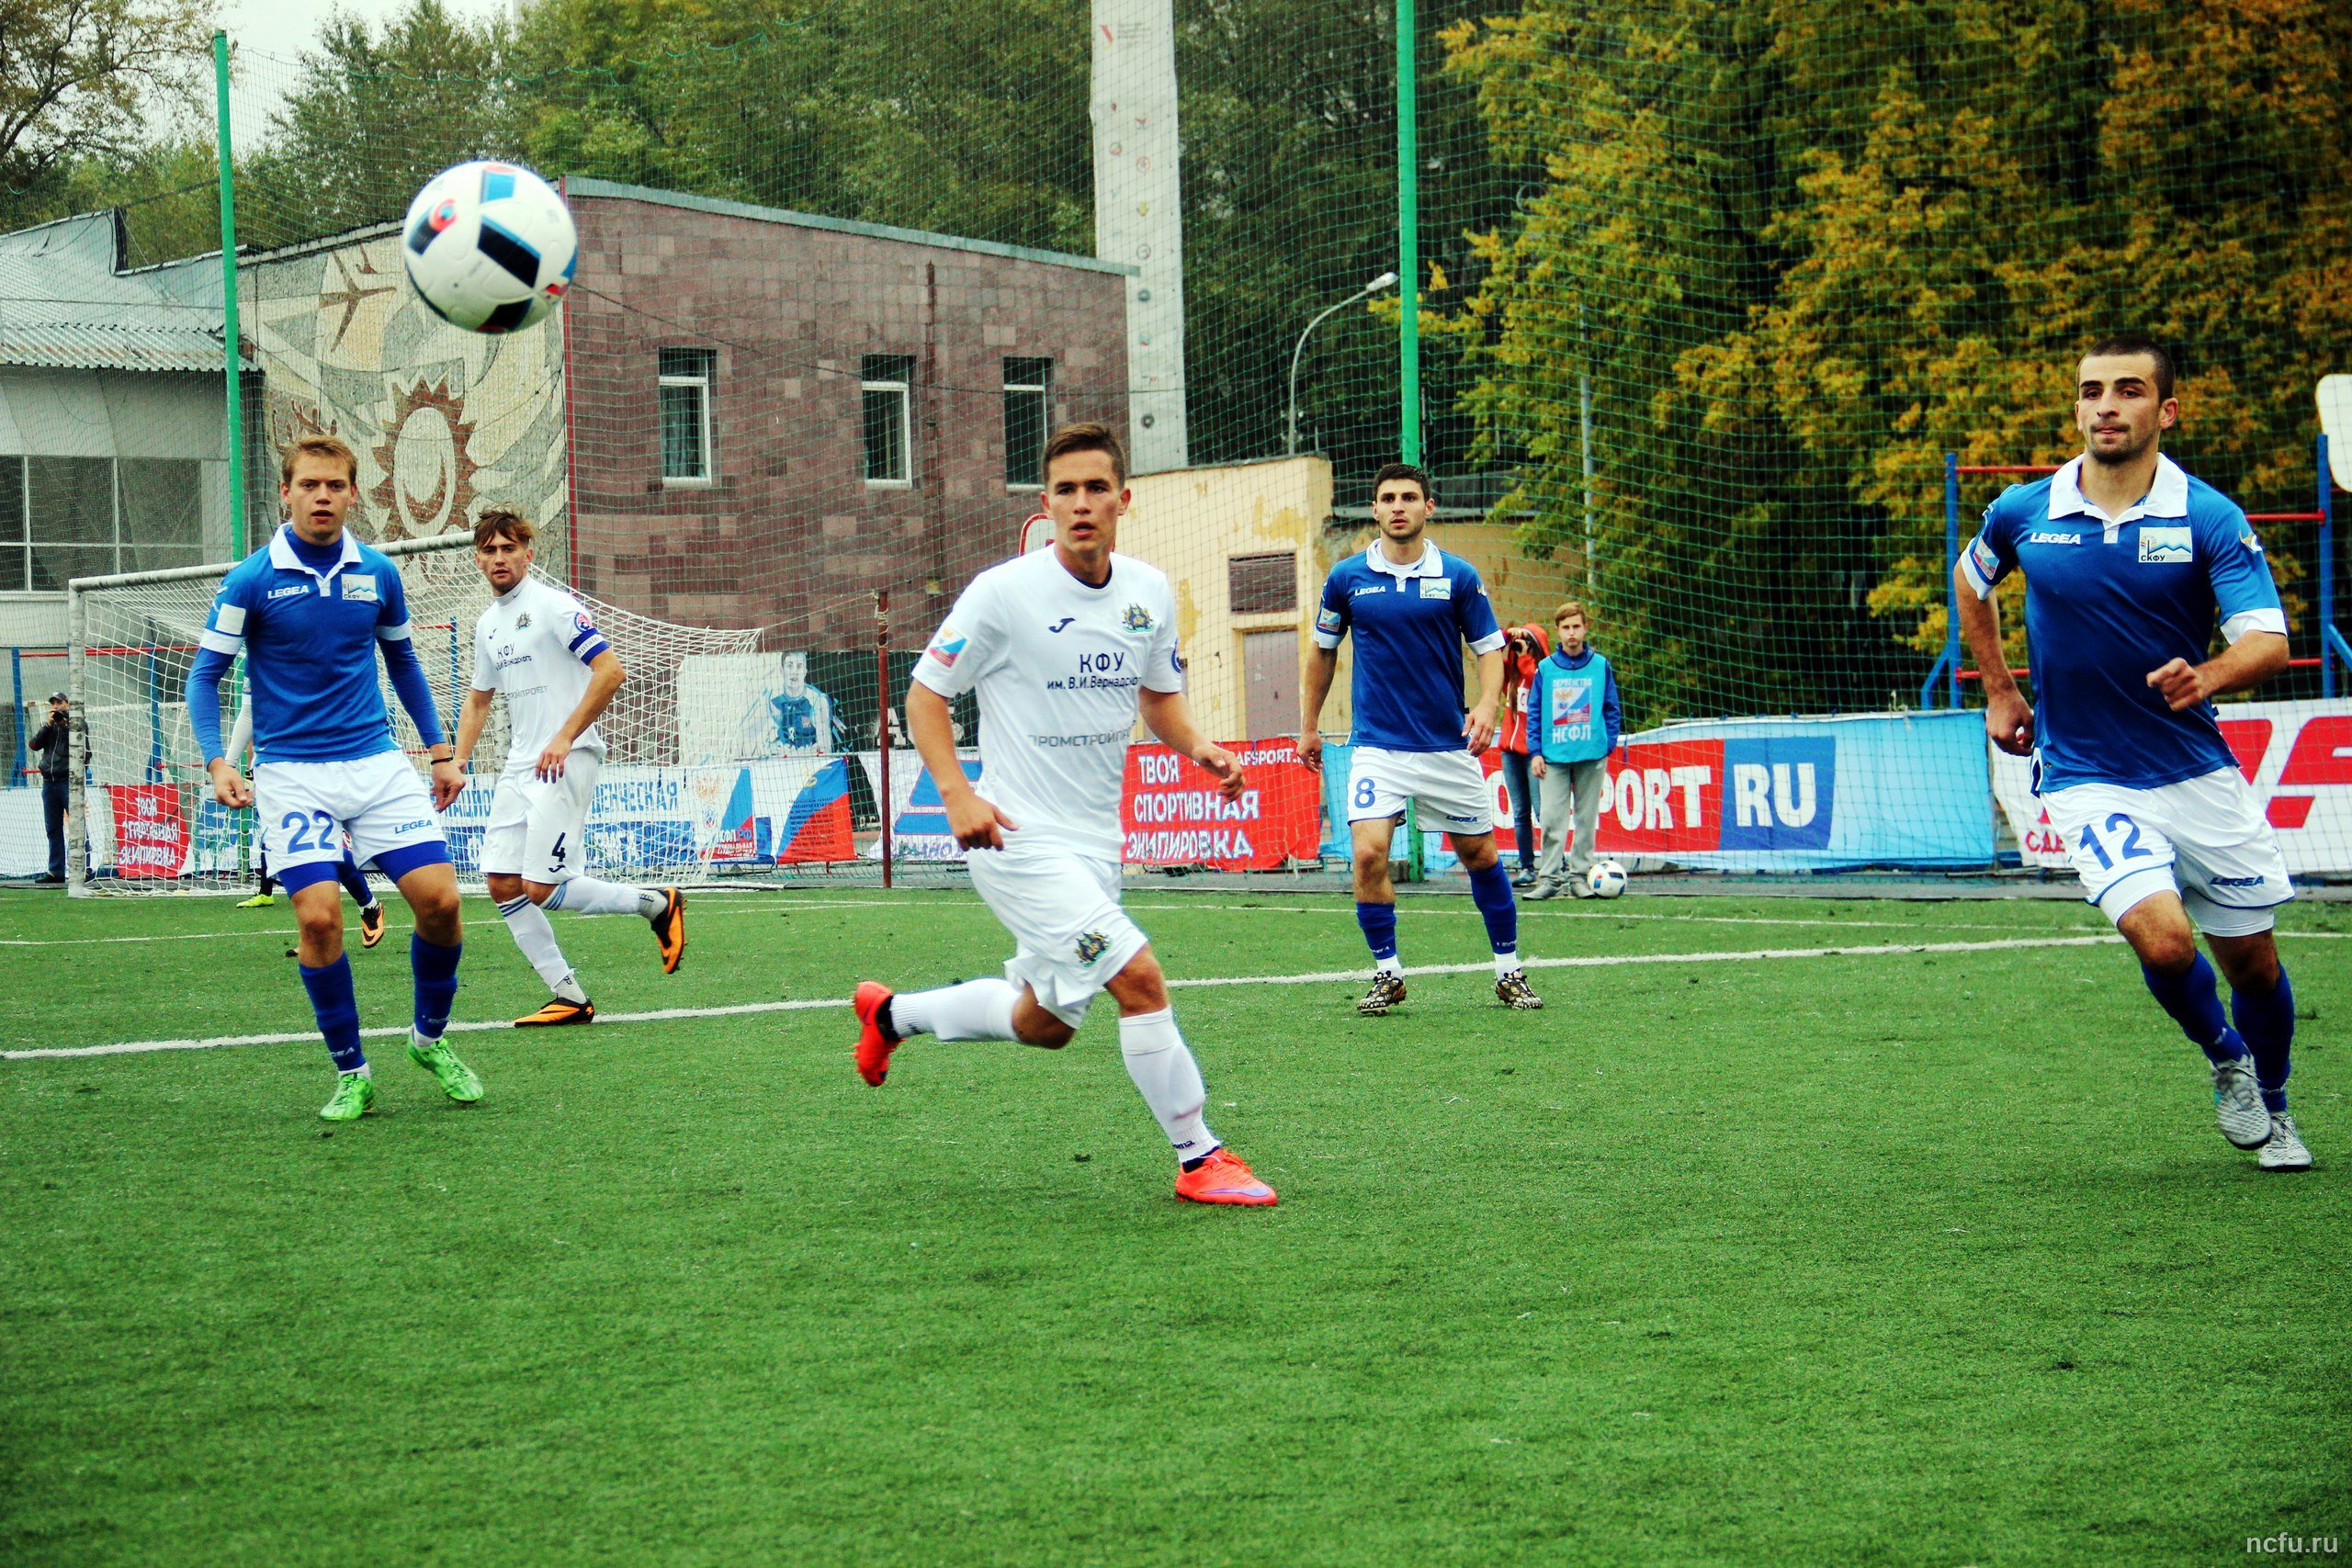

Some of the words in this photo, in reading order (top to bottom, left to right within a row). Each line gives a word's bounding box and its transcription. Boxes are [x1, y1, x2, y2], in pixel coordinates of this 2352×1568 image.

[2030, 532, 2081, 545] LEGEA
[267, 585, 309, 599] LEGEA
[1354, 585, 1386, 596] LEGEA
[1080, 652, 1125, 672] КФУ
[1553, 725, 1591, 745] НСФЛ
[1138, 754, 1180, 784] ТВОЯ
[1134, 789, 1260, 823] СПОРТИВНАЯ
[1354, 779, 1375, 808] 8
[1733, 762, 1816, 828] RU
[281, 810, 336, 854] 22
[394, 819, 433, 835] LEGEA
[551, 832, 566, 862] 4
[1126, 829, 1254, 861] ЭКИПИРОВКА
[2079, 813, 2153, 871] 12
[2210, 875, 2265, 887] LEGEA
